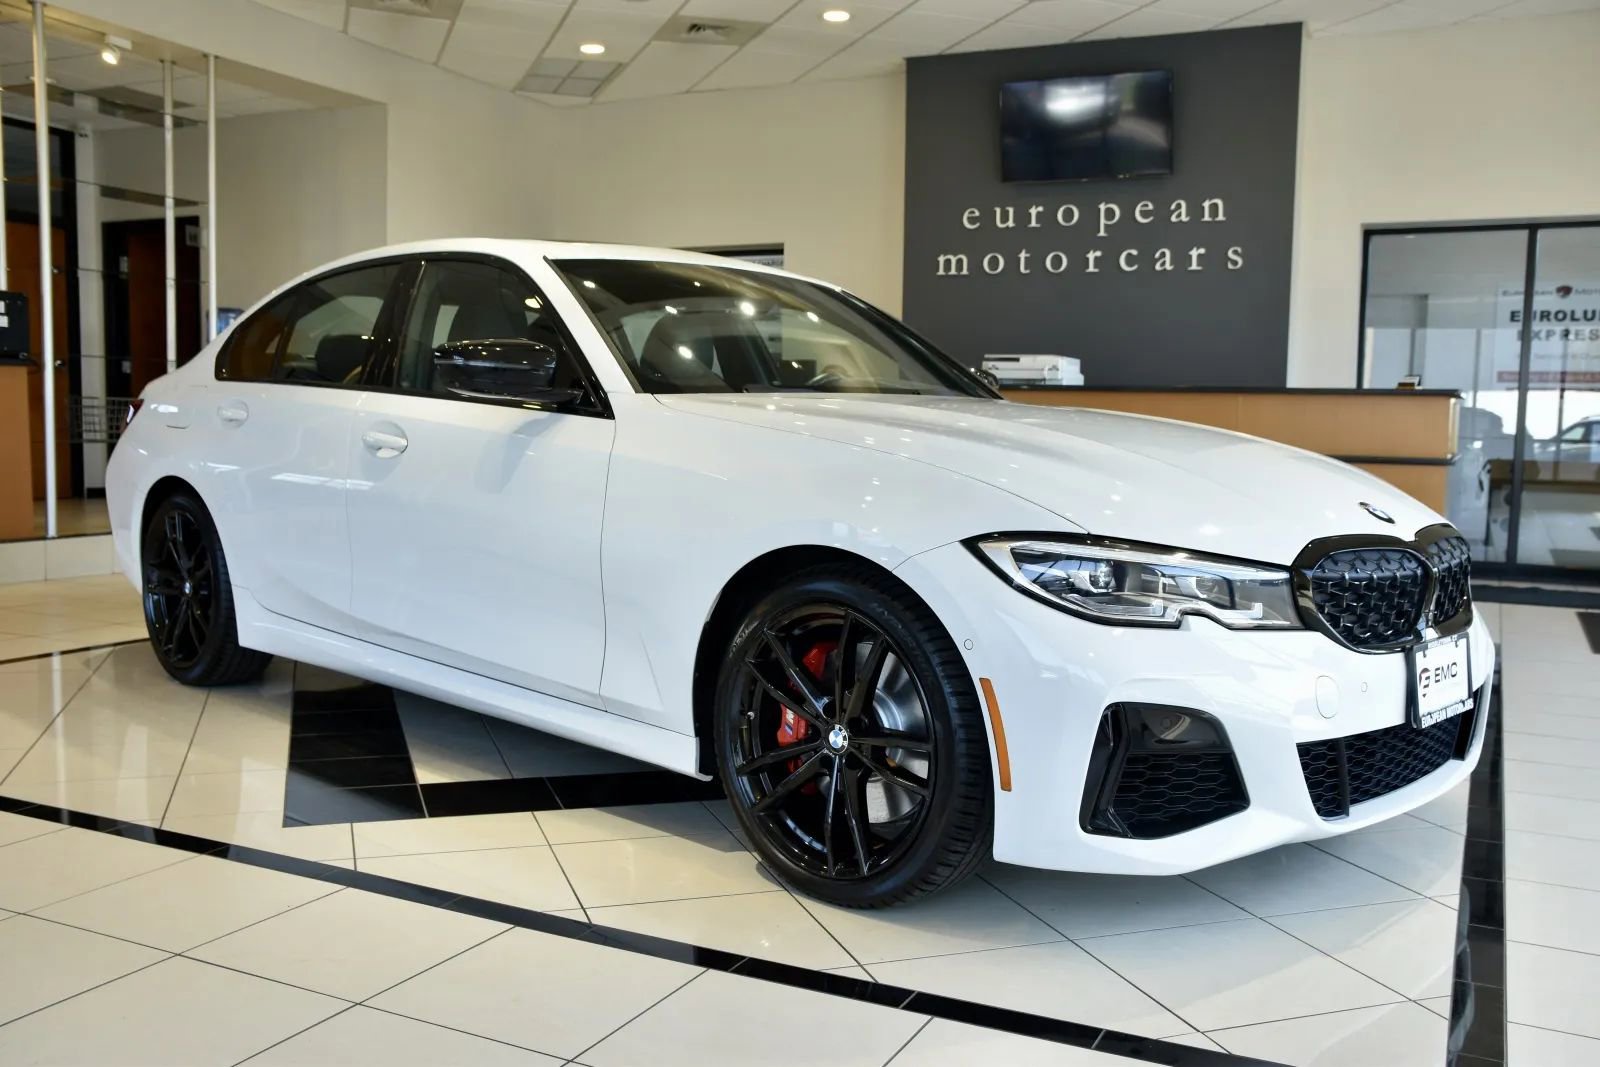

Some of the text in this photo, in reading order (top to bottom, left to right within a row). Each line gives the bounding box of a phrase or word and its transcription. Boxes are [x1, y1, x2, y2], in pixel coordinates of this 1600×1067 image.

[961, 198, 1227, 238] european
[936, 246, 1245, 276] motorcars
[1509, 309, 1600, 323] EROLU
[1434, 661, 1458, 684] EMC
